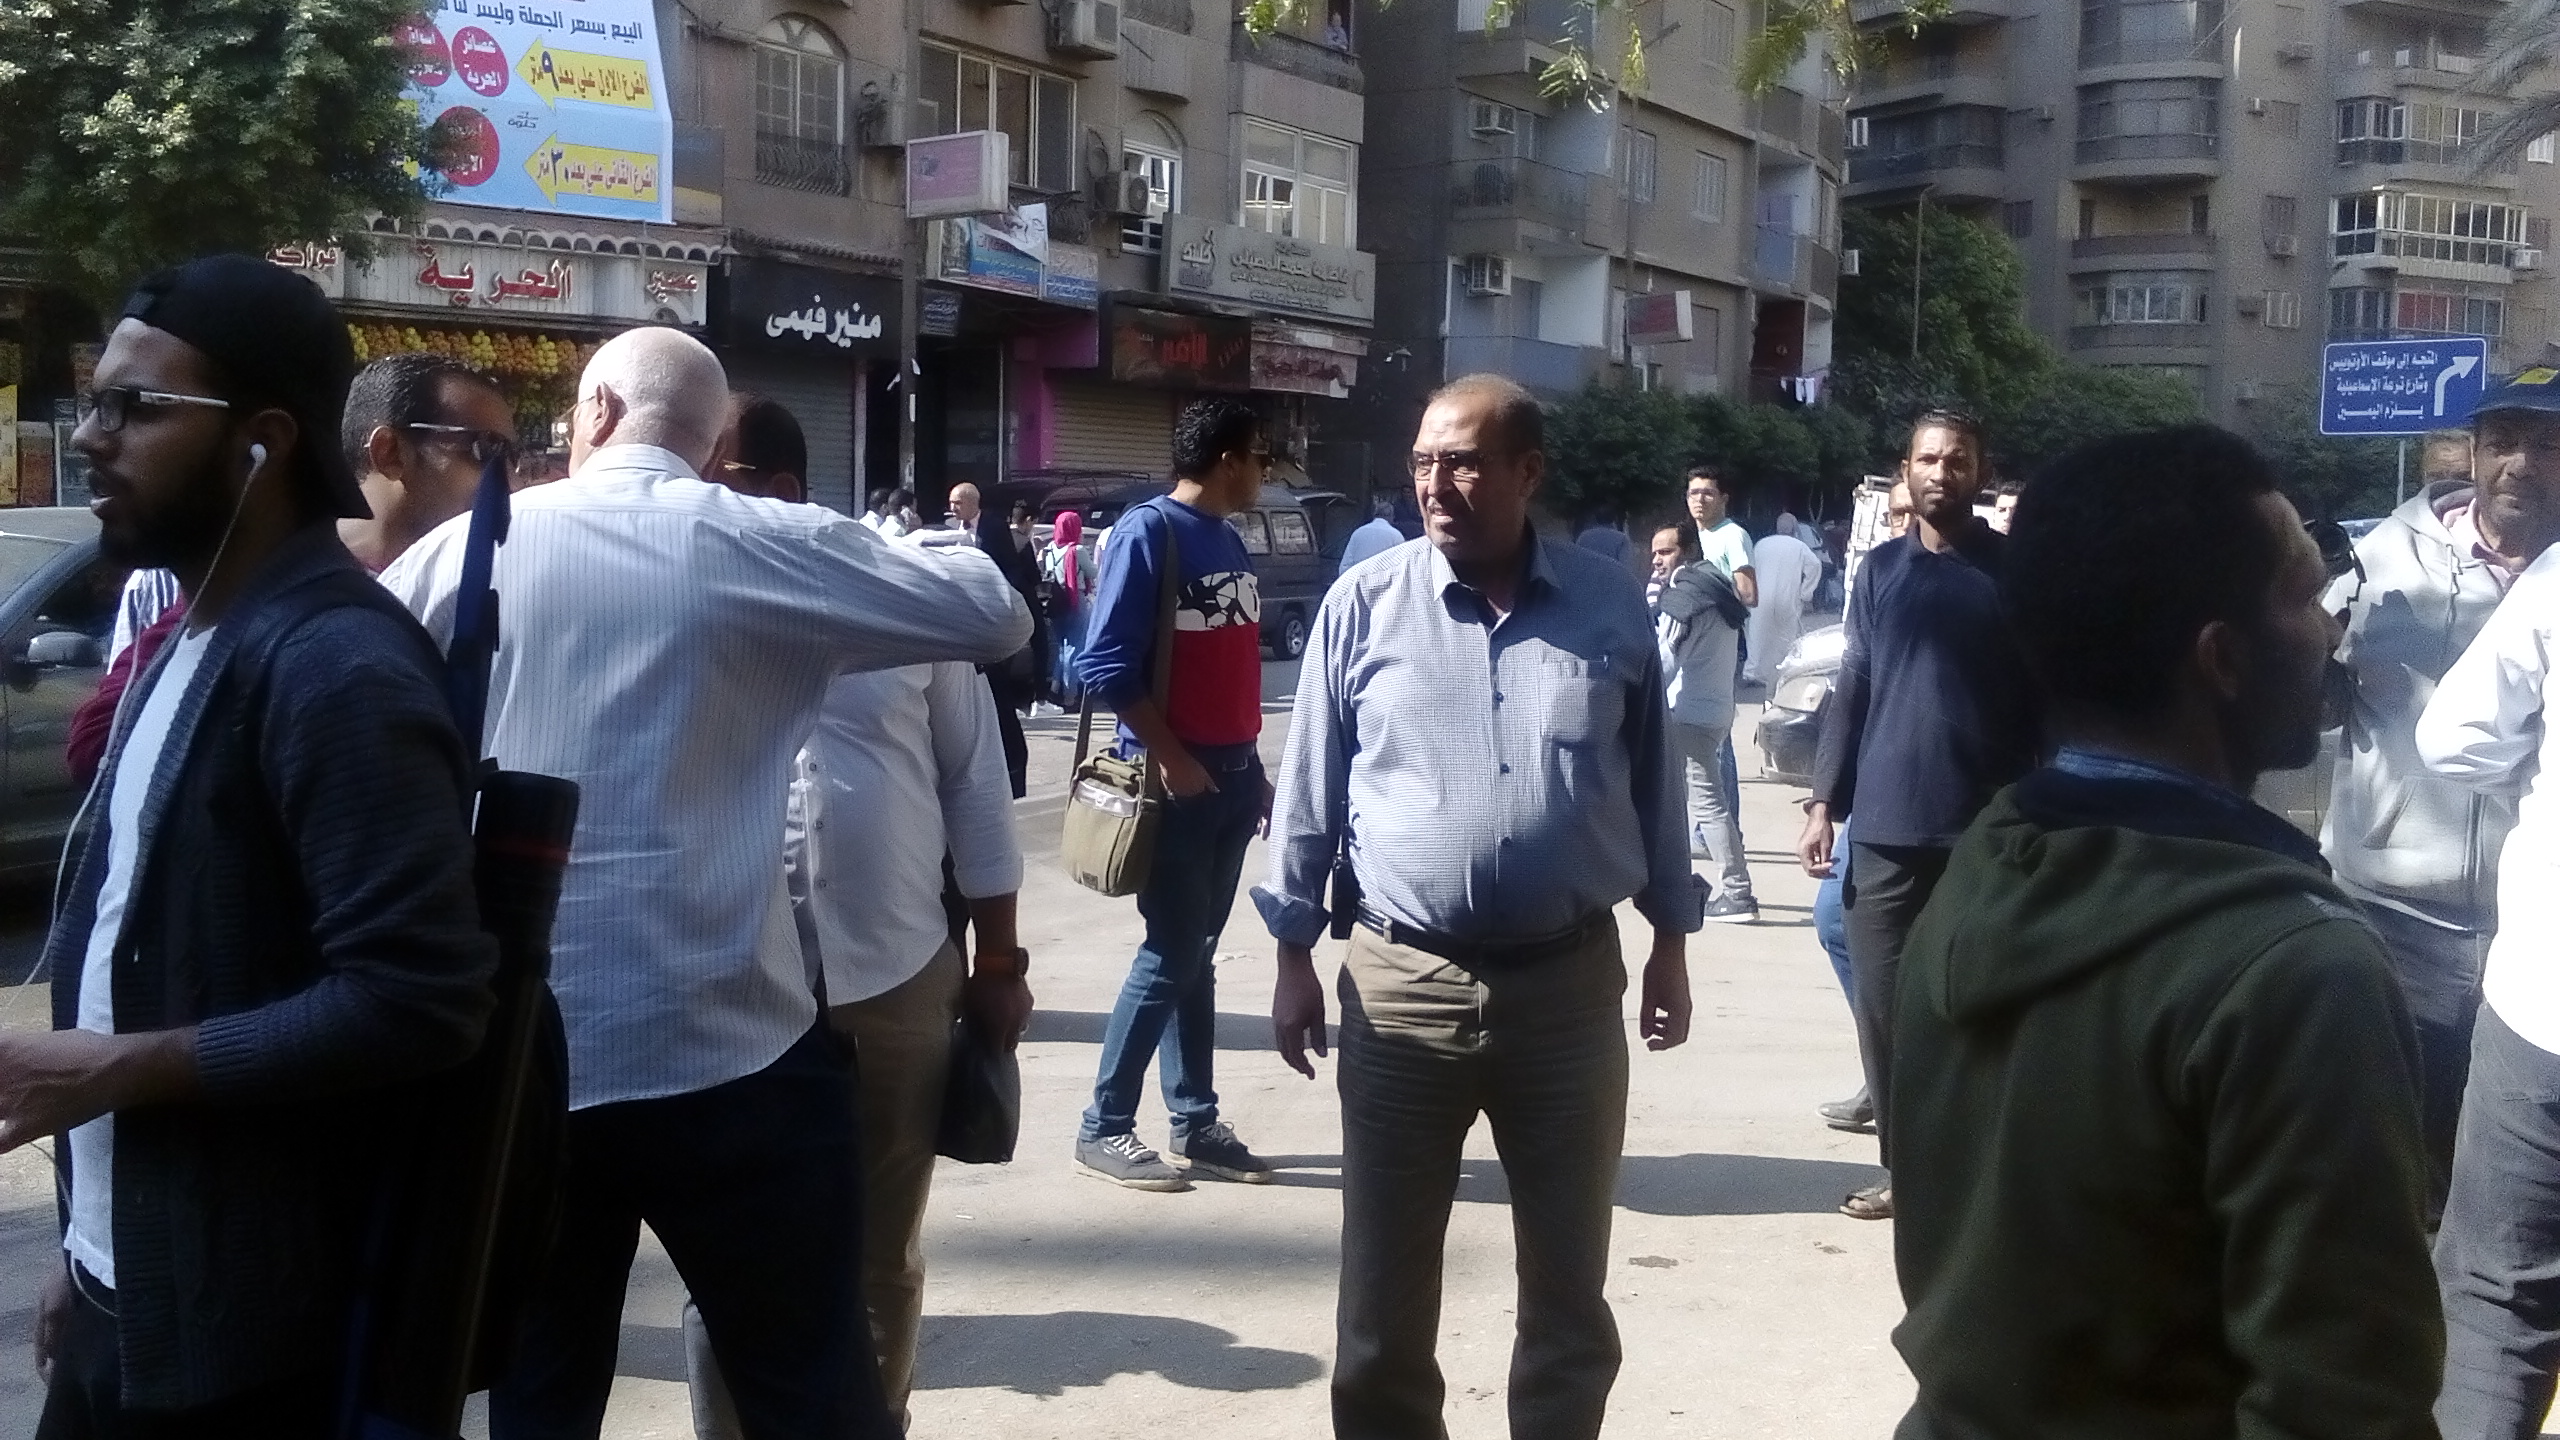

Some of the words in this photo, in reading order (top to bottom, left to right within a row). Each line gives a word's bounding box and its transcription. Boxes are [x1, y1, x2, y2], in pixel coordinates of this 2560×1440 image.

[476, 1, 515, 26] وليس
[519, 5, 563, 33] الجملة
[570, 17, 606, 40] بسعر
[612, 22, 643, 44] البيع
[417, 244, 574, 307] الحرية
[646, 269, 698, 304] عصير
[826, 302, 881, 348] منير
[2382, 375, 2405, 395] ترعة
[2406, 372, 2429, 396] وشارع
[2336, 403, 2384, 421] اليمين
